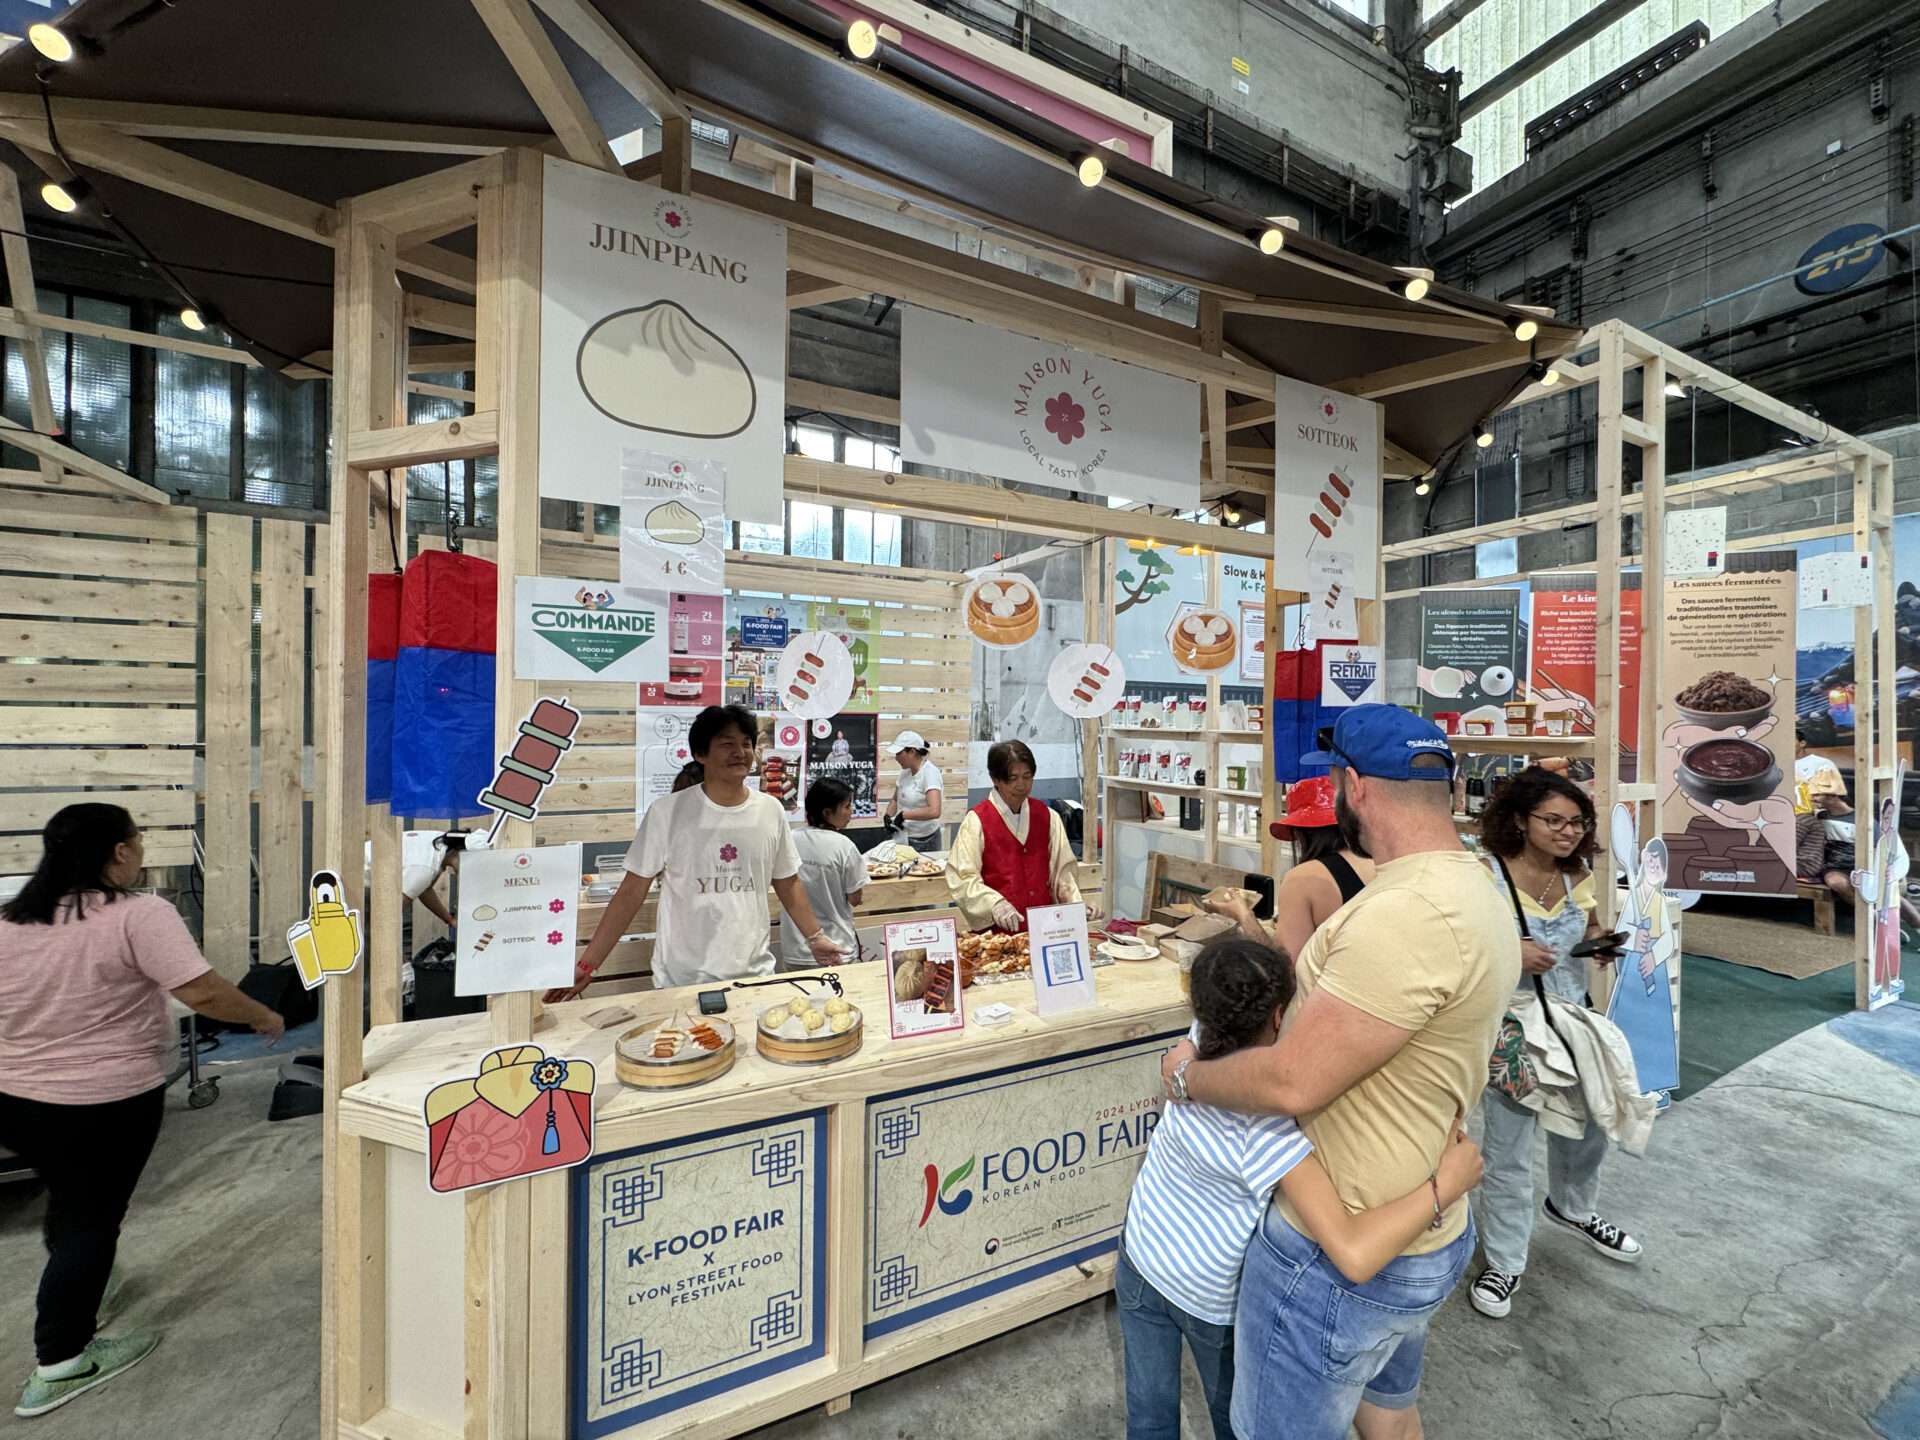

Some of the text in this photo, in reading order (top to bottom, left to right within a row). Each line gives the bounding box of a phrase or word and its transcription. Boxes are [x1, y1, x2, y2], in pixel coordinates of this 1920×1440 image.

[589, 222, 748, 284] JJINPPANG
[1014, 357, 1112, 433] MAISON YUGA
[1297, 423, 1359, 453] SOTTEOK
[1019, 428, 1108, 478] LOCAL TASTY KOREA
[661, 559, 688, 576] 4 €
[1223, 564, 1248, 578] Slow
[1249, 568, 1258, 579] &
[1673, 576, 1782, 589] Les sauces fermentées
[1561, 594, 1576, 603] Le
[1724, 595, 1771, 604] fermentées
[1734, 603, 1778, 611] transmises
[531, 609, 656, 633] COMMANDE
[1679, 613, 1726, 621] générations
[1738, 611, 1787, 620] générations
[1330, 664, 1377, 678] RETRAIT
[809, 760, 874, 770] MAISON YUGA
[696, 875, 755, 894] YUGA
[1096, 1096, 1159, 1121] 2024 LYON
[982, 1131, 1086, 1191] FOOD
[1098, 1111, 1161, 1157] FAIR
[982, 1166, 1086, 1205] KOREAN FOOD
[628, 1208, 785, 1268] K-FOOD FAIR
[703, 1250, 715, 1266] X
[628, 1250, 784, 1306] LYON STREET FOOD
[671, 1276, 746, 1307] FESTIVAL
